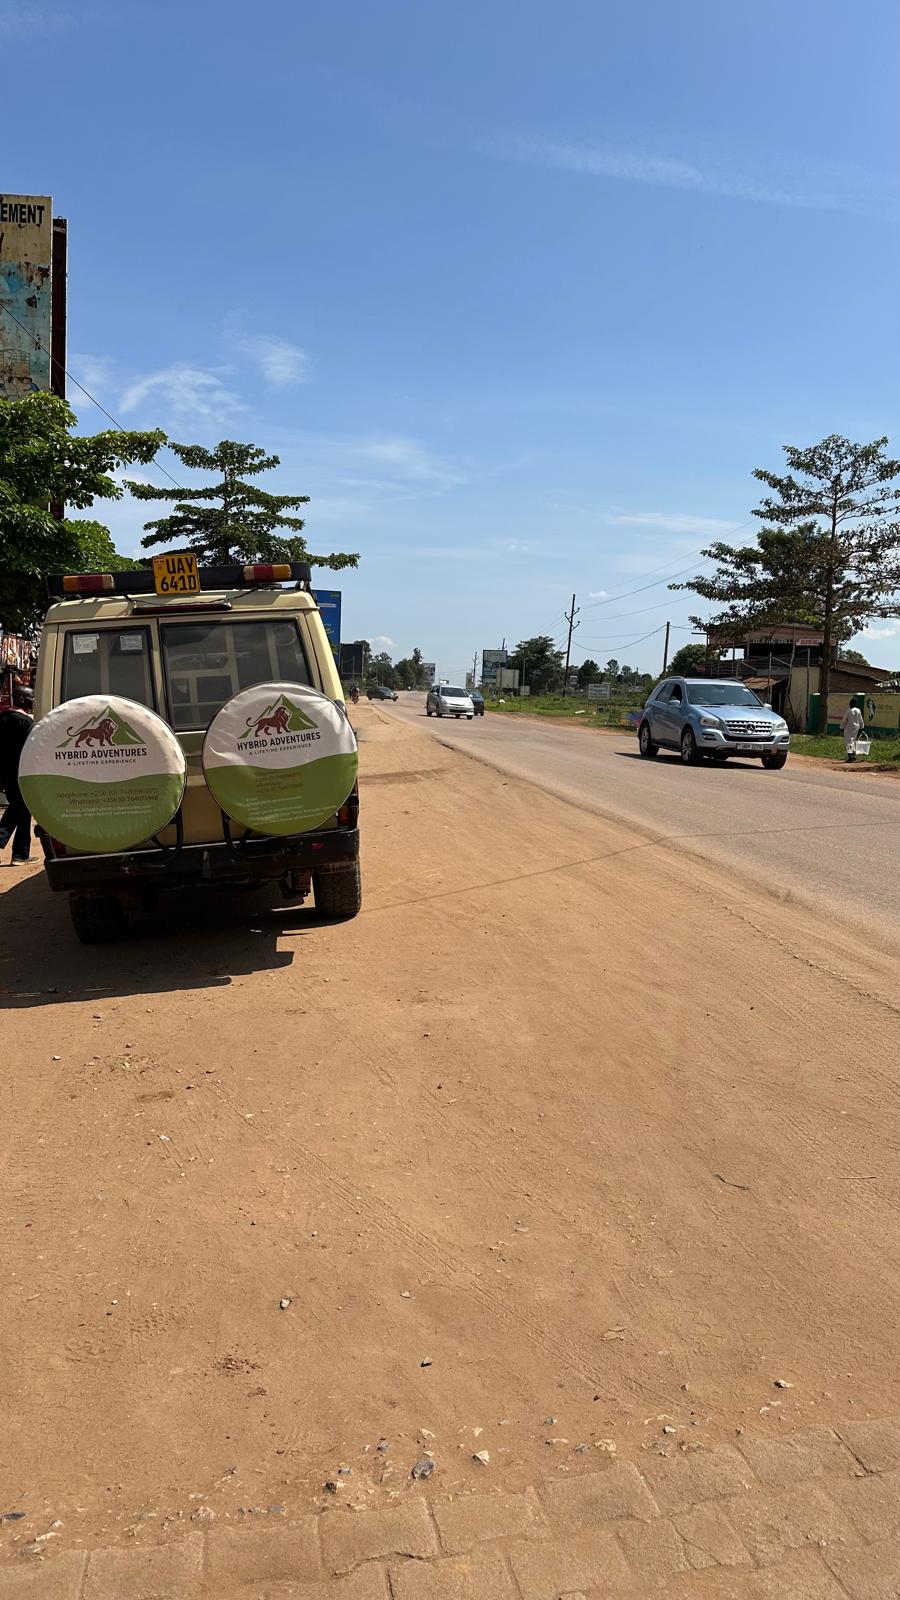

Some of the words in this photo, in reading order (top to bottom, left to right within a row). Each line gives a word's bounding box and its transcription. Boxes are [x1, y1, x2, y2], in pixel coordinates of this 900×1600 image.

[166, 557, 194, 574] UAY
[161, 575, 197, 592] 641D
[237, 739, 268, 751] HYBRID
[270, 732, 321, 746] ADVENTURES
[280, 744, 312, 752] EXPERIENCE
[55, 750, 88, 760] HYBRID
[91, 748, 147, 759] ADVENTURES
